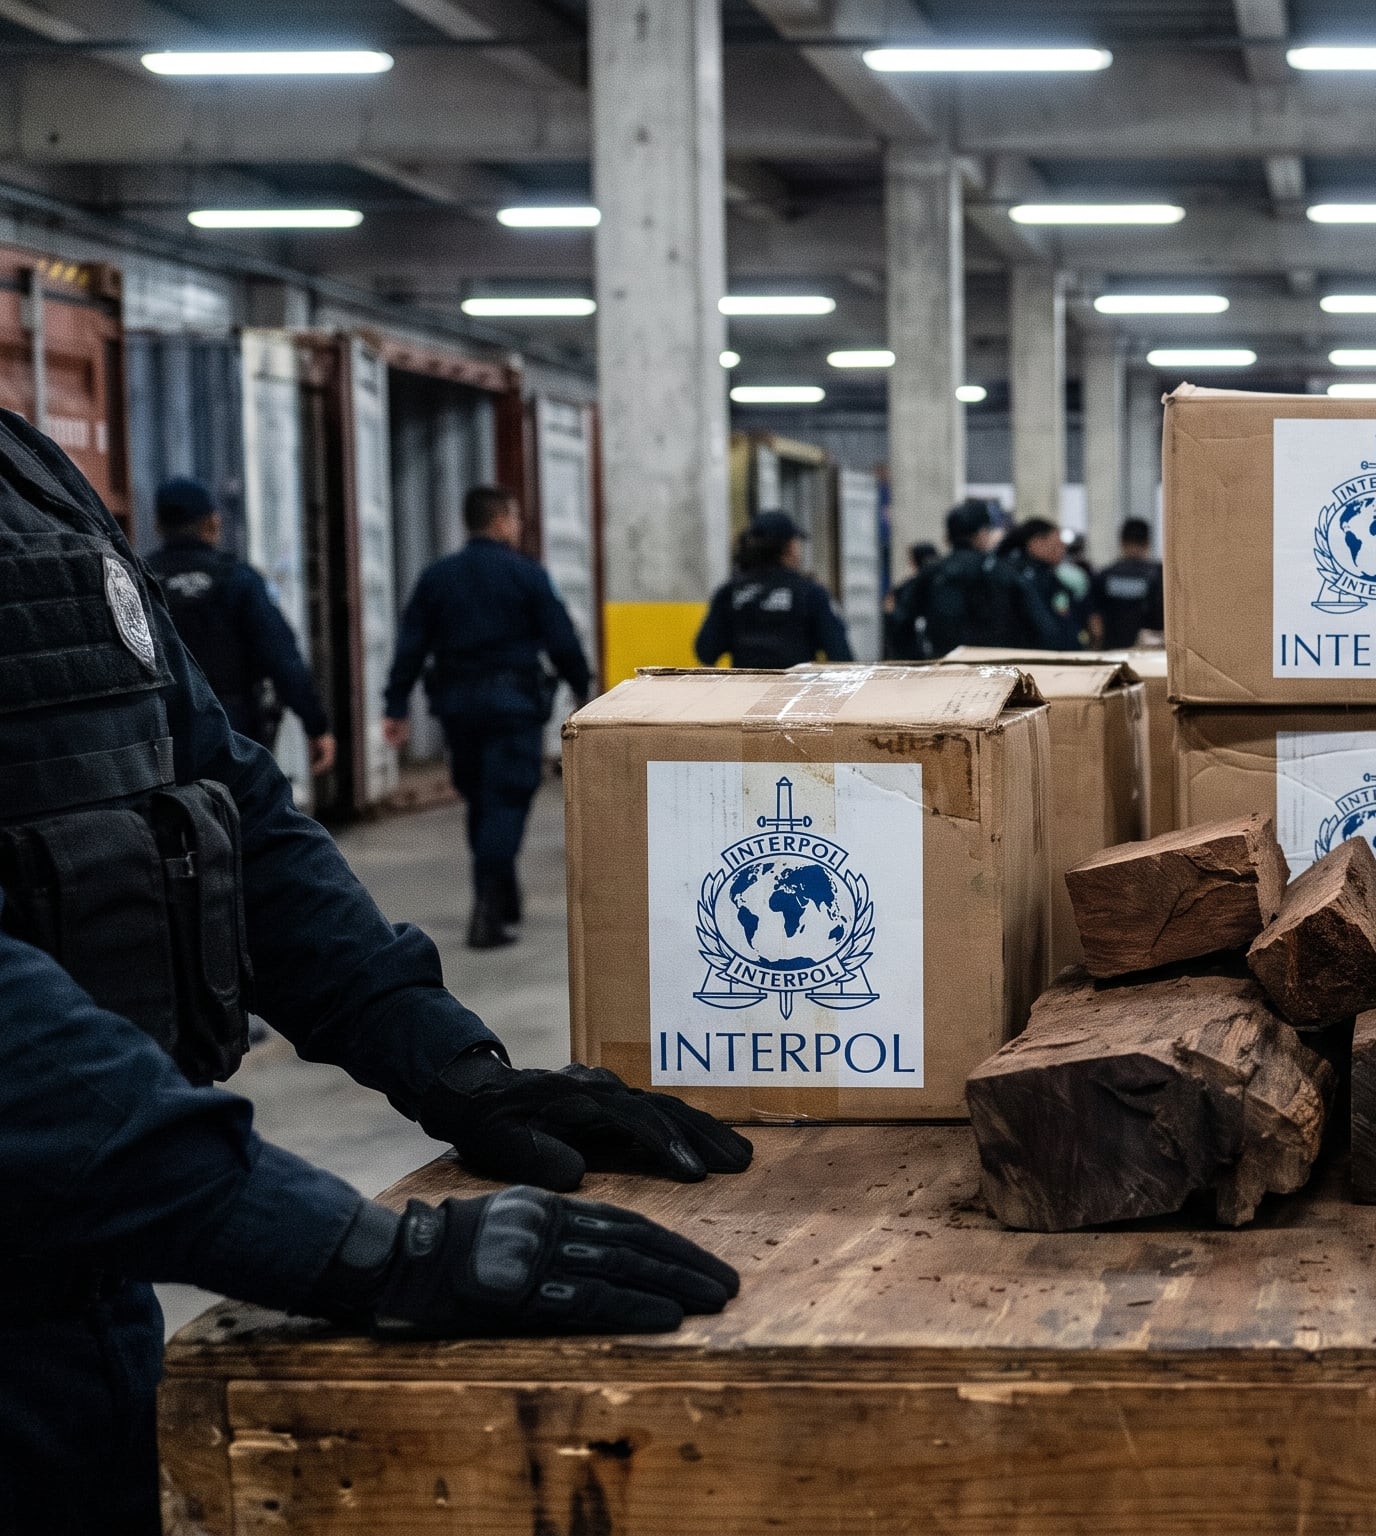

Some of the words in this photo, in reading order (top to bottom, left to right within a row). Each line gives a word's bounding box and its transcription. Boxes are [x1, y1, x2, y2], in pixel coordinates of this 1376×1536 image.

[730, 836, 839, 866] INTERPOL
[733, 960, 839, 988] INTERPOL
[660, 1031, 915, 1074] INTERPOL
